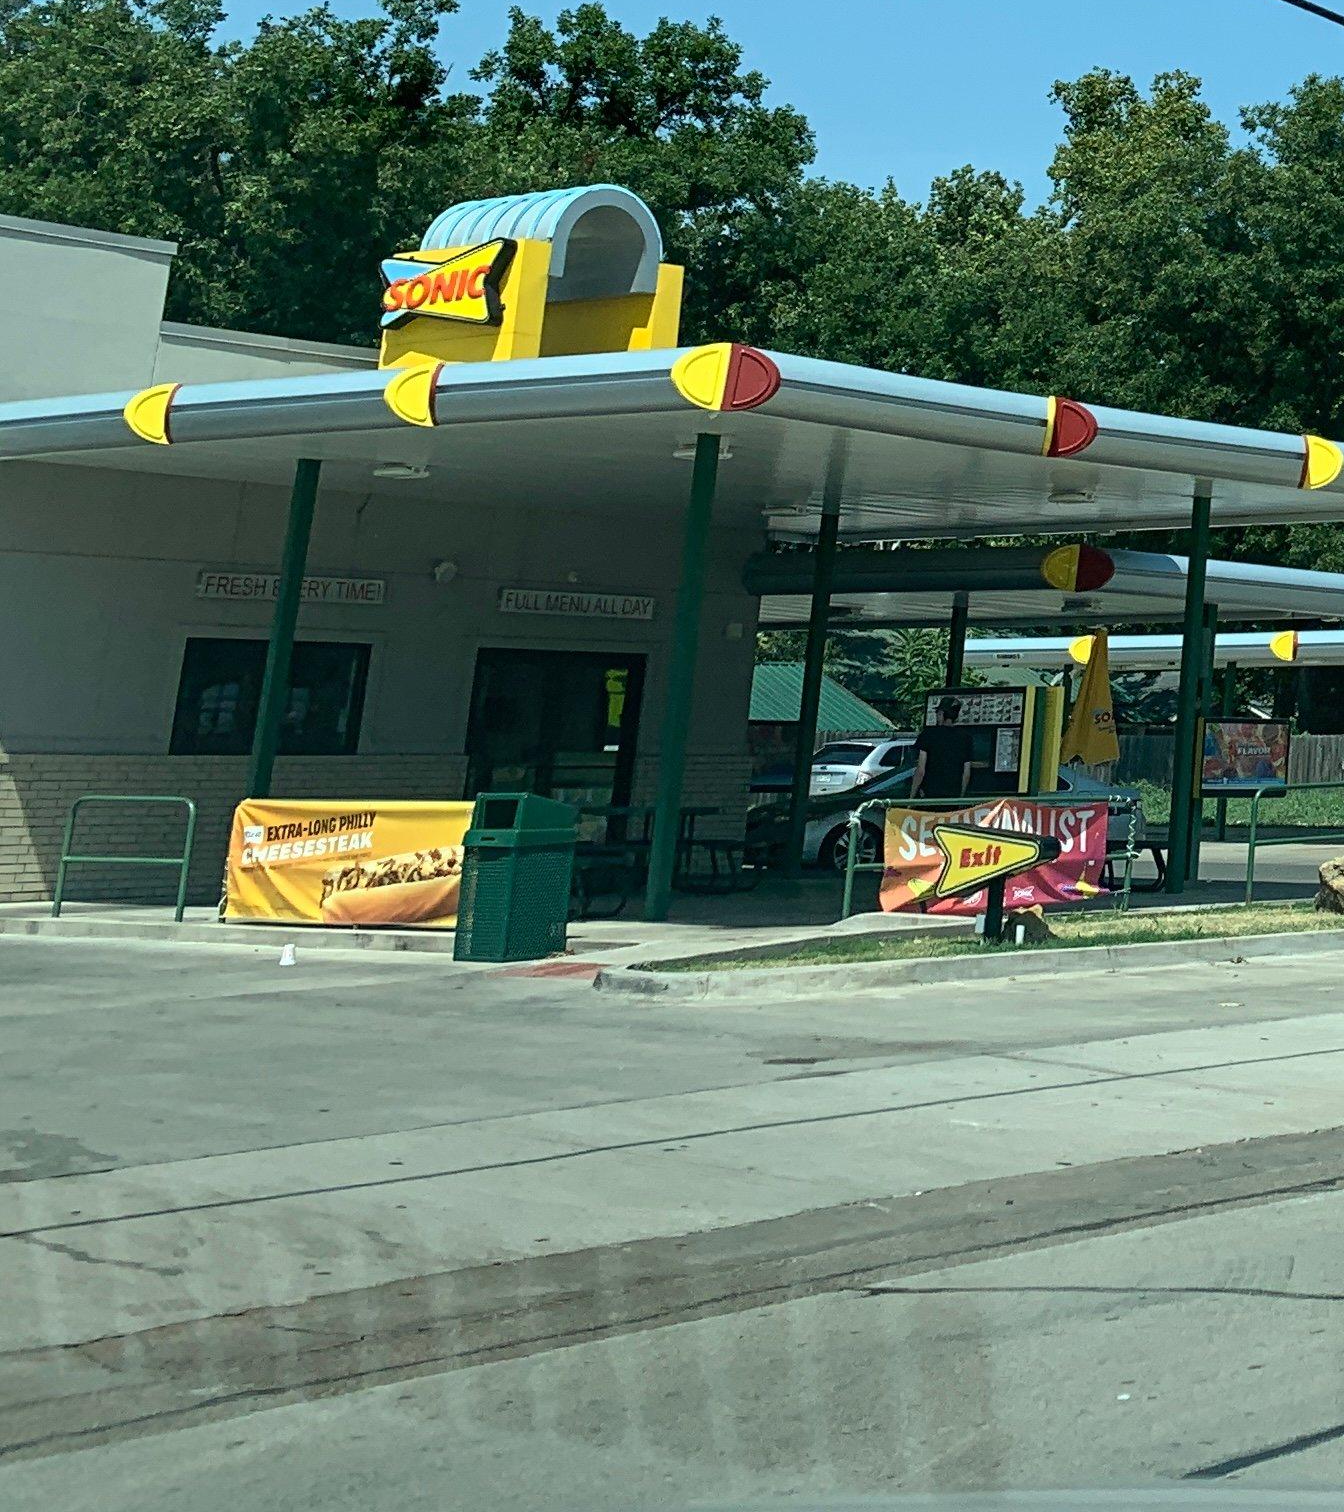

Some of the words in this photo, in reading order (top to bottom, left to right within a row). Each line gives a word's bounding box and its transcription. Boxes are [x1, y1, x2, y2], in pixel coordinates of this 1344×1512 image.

[384, 264, 492, 312] SONIC
[204, 575, 267, 597] FRESH
[272, 578, 332, 600] EERY
[335, 580, 382, 602] TIME!
[505, 591, 541, 611] FULL
[544, 594, 592, 614] MENU
[594, 597, 618, 615] ALL
[620, 598, 651, 616] DAY
[266, 818, 337, 842] EXTRA-LONG
[338, 810, 378, 831] PHILLY
[959, 846, 1002, 869] Exit
